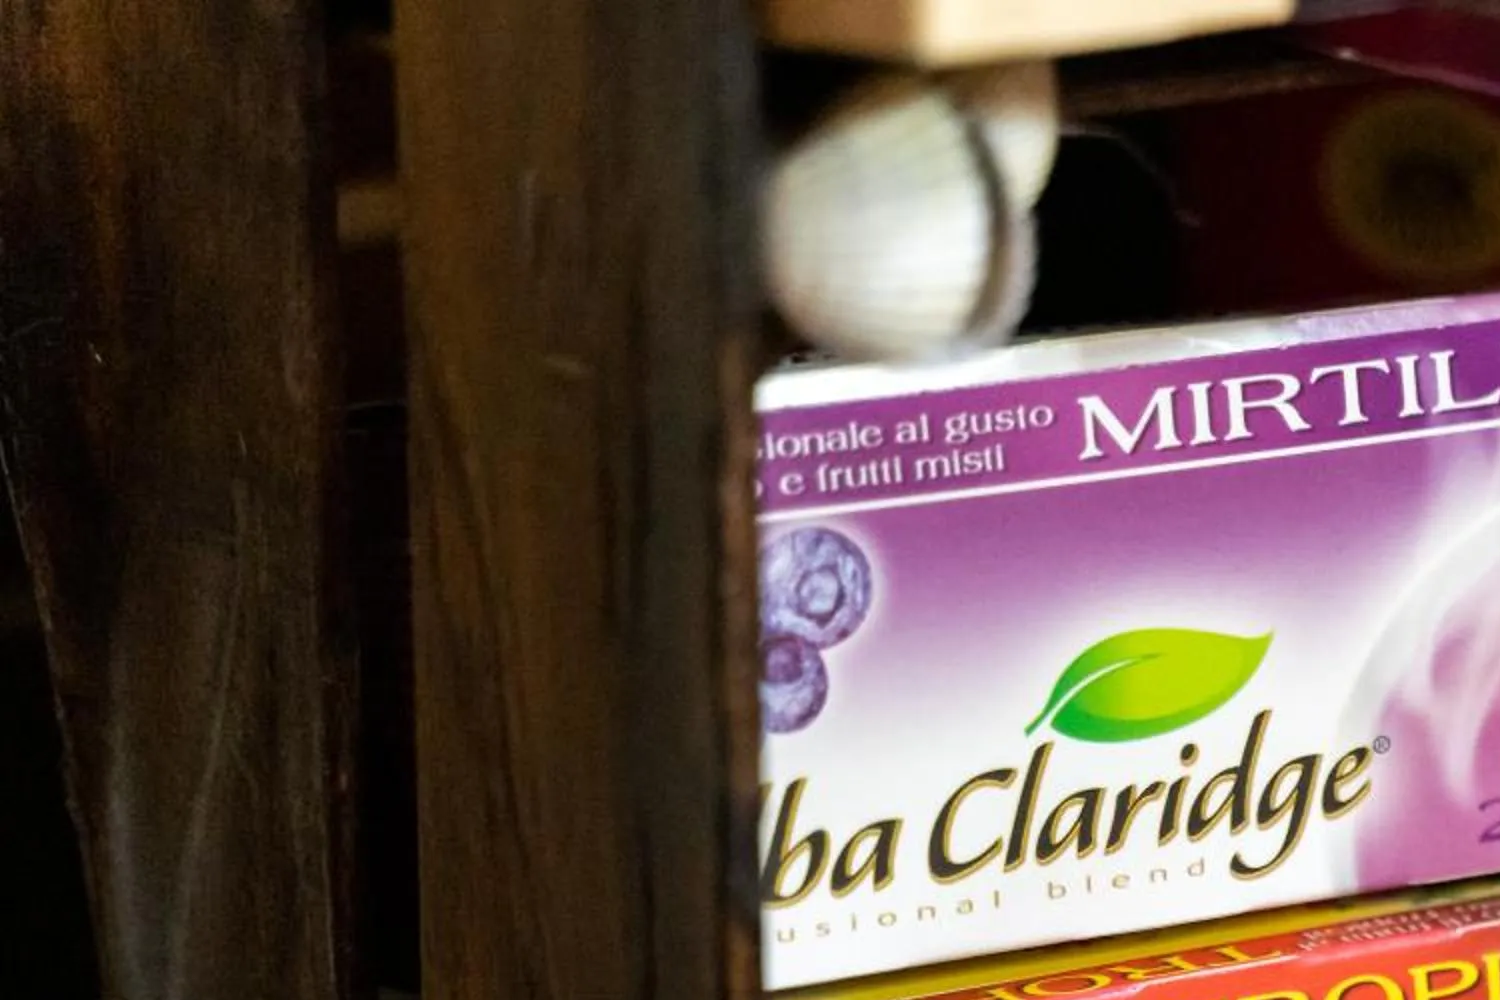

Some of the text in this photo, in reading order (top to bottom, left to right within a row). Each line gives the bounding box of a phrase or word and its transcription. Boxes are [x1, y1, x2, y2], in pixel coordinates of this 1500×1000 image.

[757, 404, 1055, 462] ionale al gusto
[778, 471, 805, 496] e
[817, 455, 902, 493] frutti
[914, 443, 1005, 482] misti
[1046, 857, 1206, 902] blend
